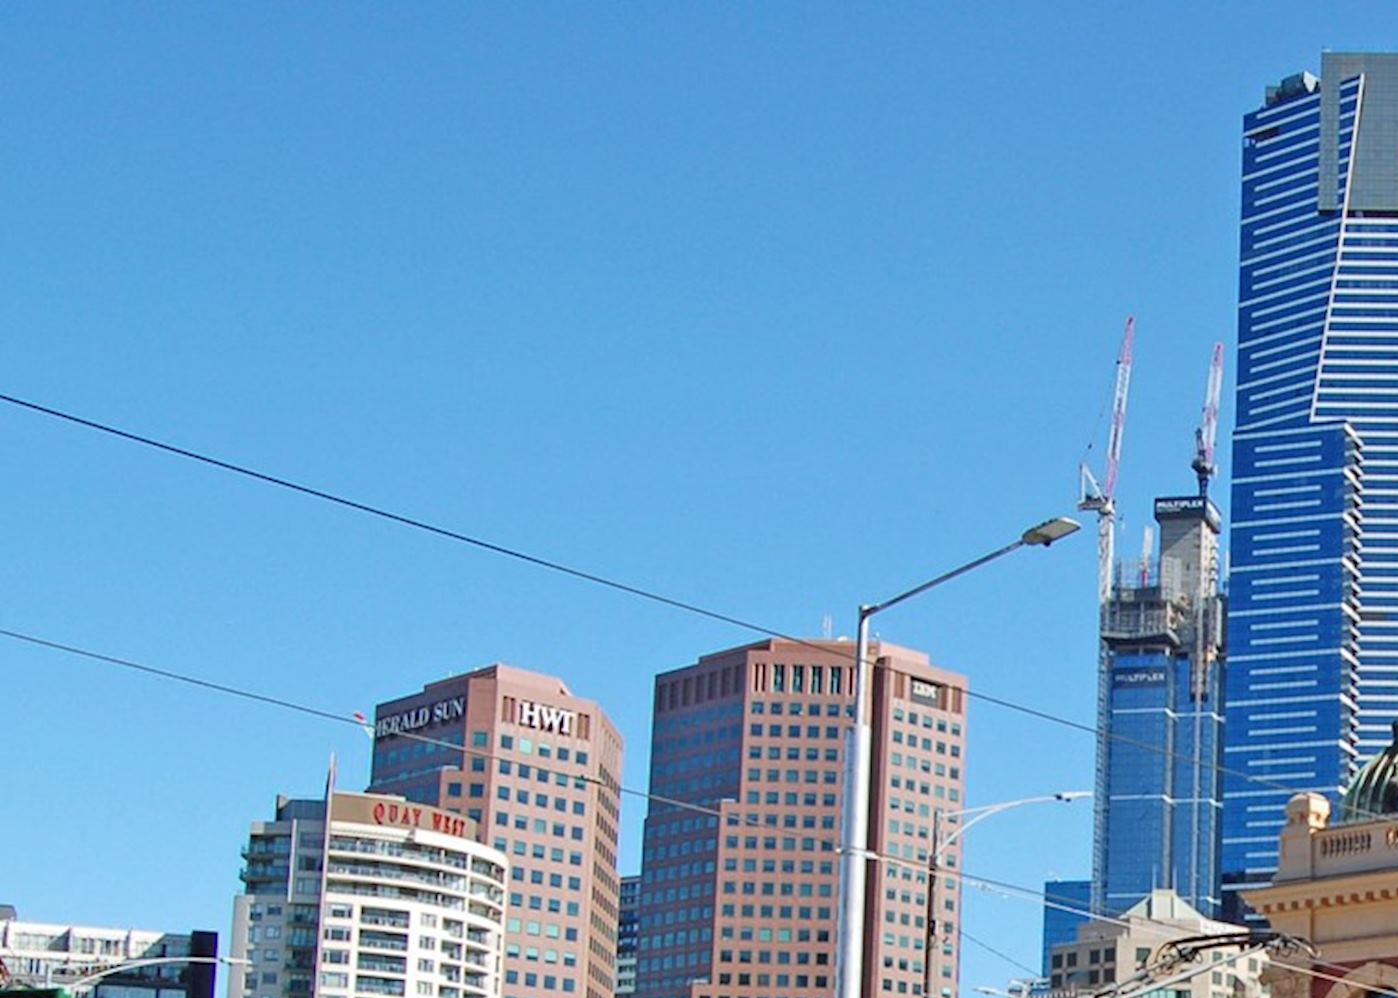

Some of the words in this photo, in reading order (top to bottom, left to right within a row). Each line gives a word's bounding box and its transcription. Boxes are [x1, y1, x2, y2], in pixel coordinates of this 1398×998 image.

[1156, 500, 1204, 508] MULTIPLEX
[434, 697, 464, 722] SUN
[521, 702, 575, 733] HWT
[374, 803, 422, 827] QUAY
[433, 811, 465, 837] WEST
